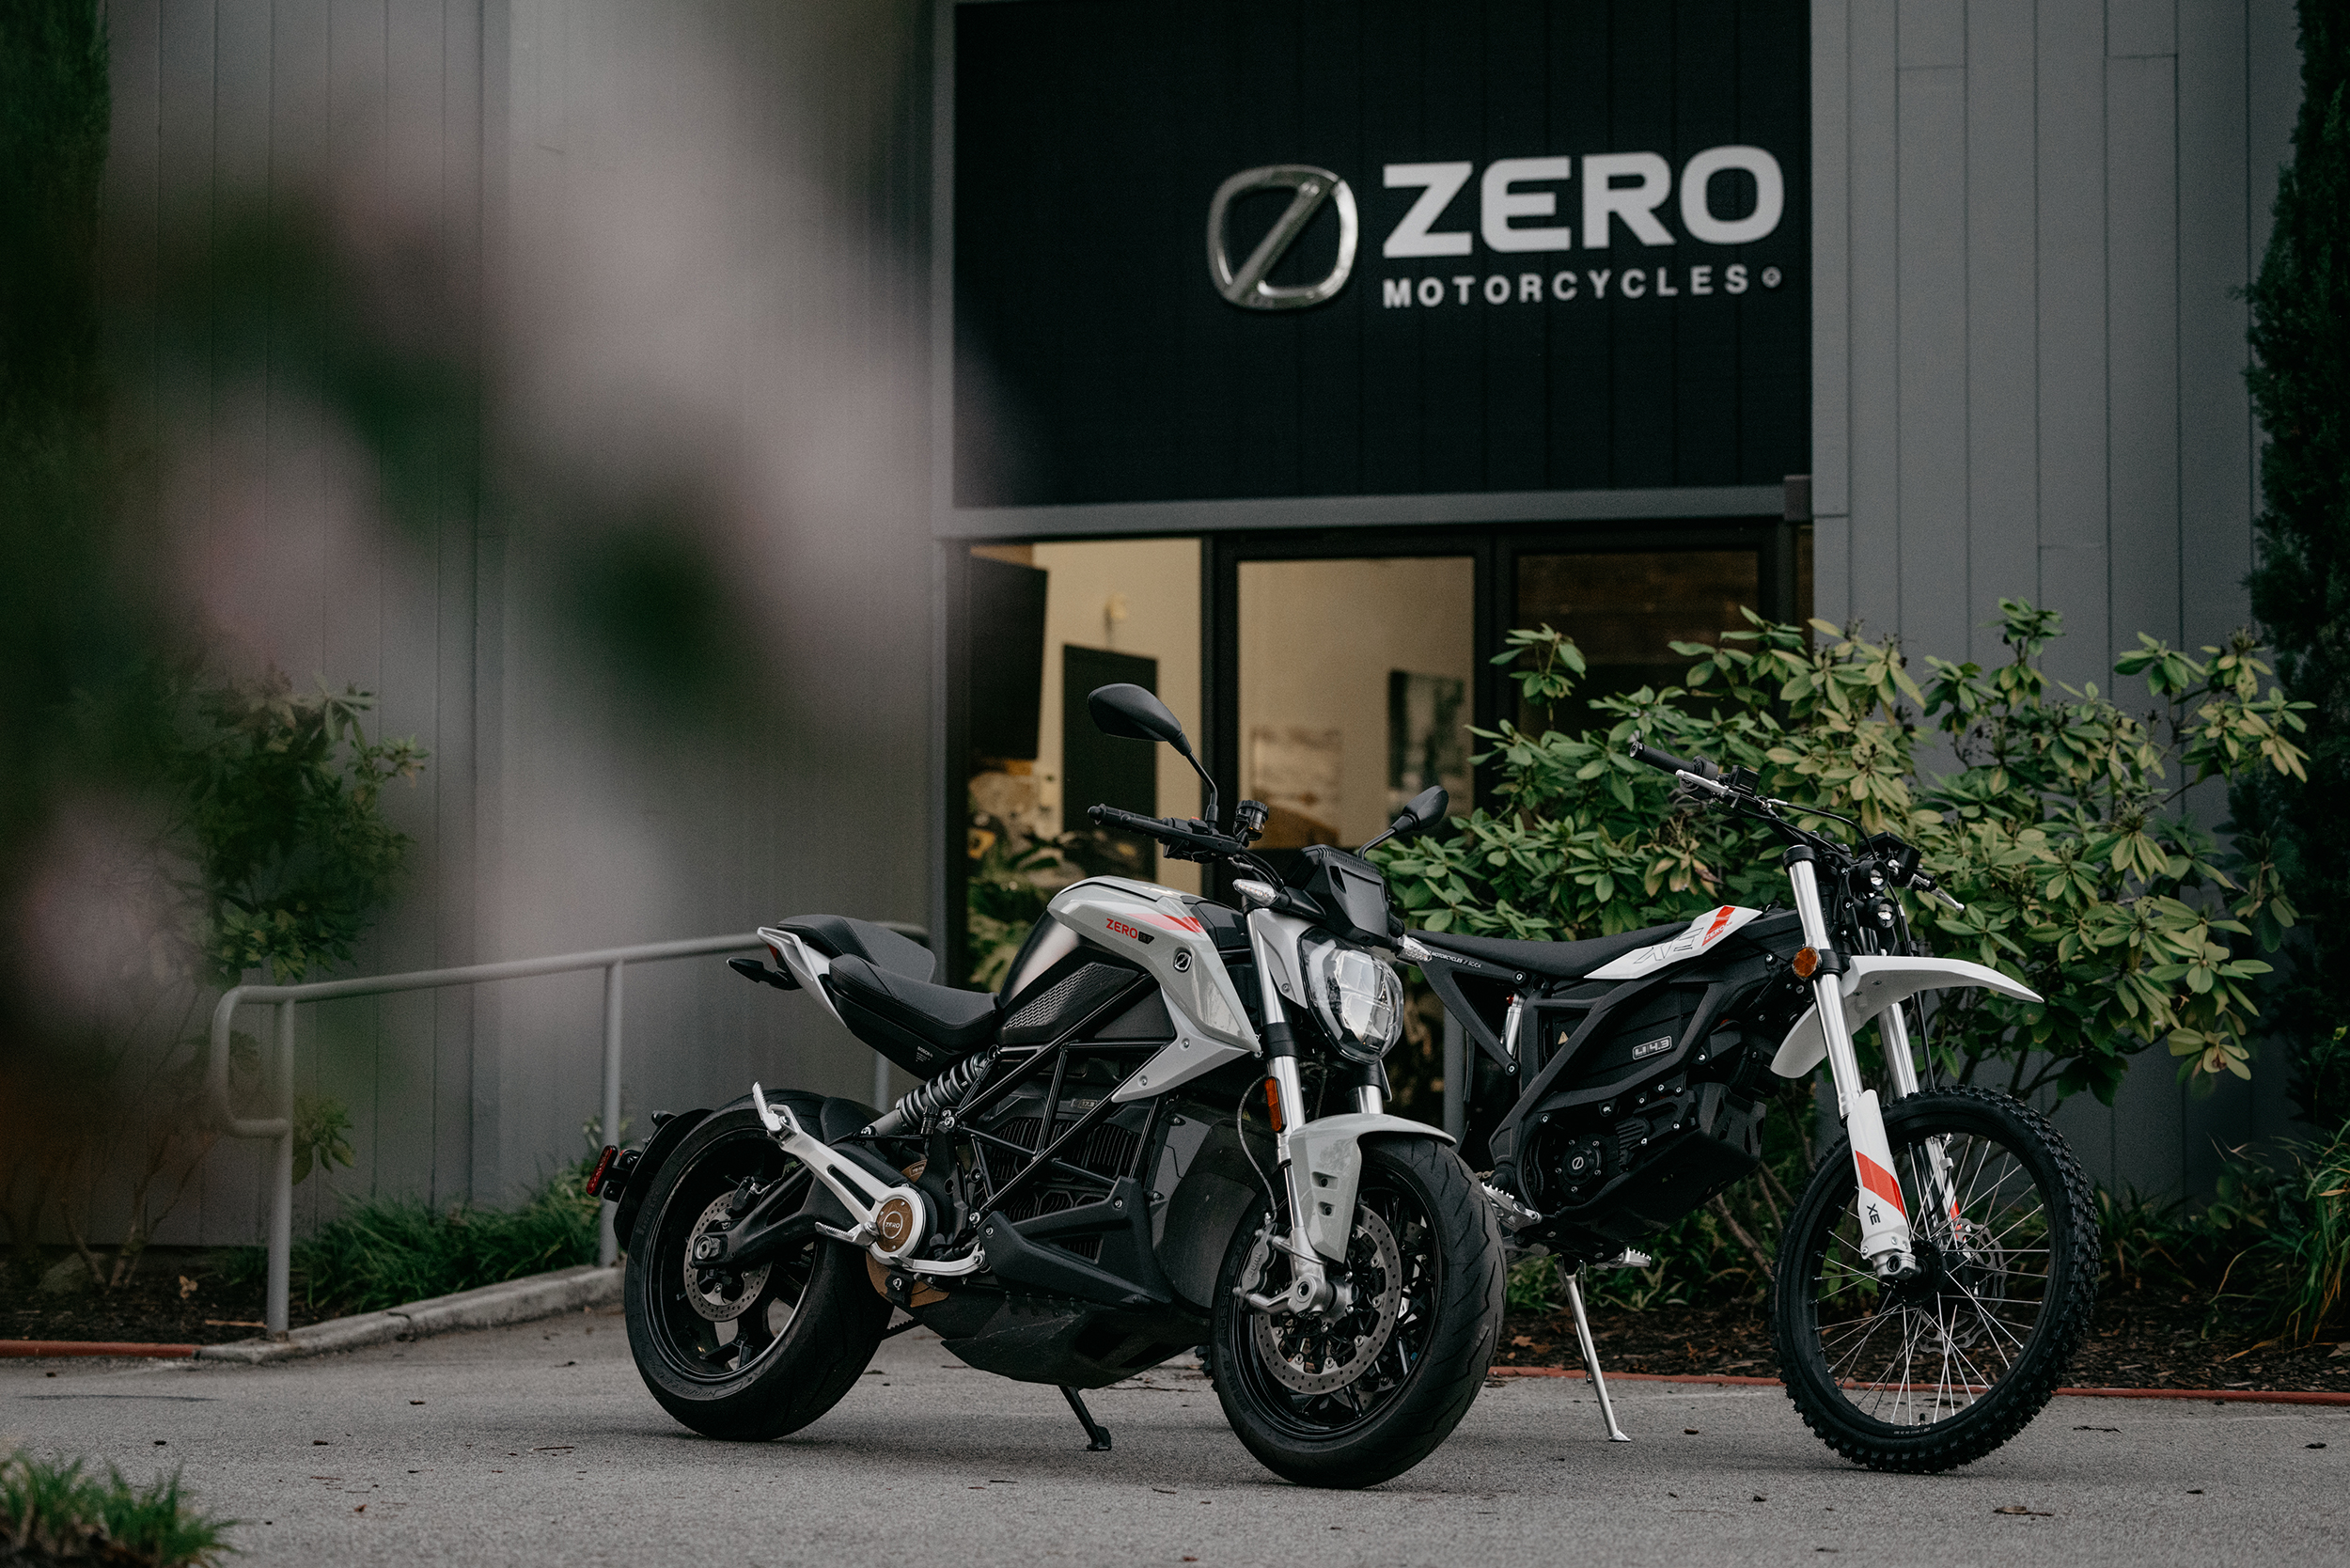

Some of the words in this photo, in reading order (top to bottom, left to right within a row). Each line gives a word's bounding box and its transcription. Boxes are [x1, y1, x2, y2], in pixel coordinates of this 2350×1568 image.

[1383, 145, 1784, 259] ZERO
[1105, 917, 1138, 939] ZERO
[1705, 924, 1726, 941] ZERO
[1431, 950, 1463, 964] MOTORCYCLES
[1866, 1203, 1881, 1226] XE
[1218, 1284, 1232, 1339] ROSSO
